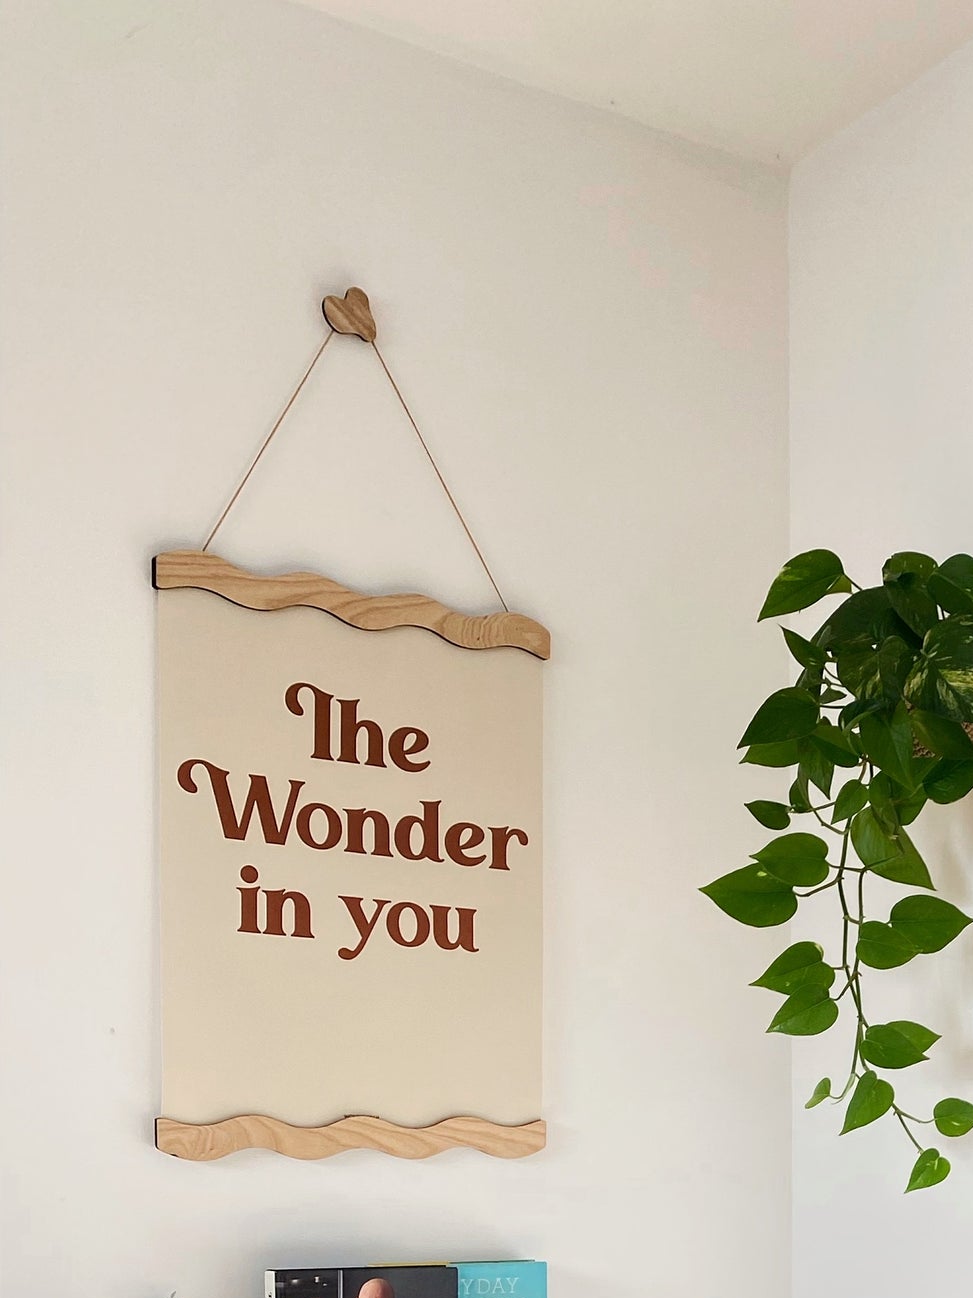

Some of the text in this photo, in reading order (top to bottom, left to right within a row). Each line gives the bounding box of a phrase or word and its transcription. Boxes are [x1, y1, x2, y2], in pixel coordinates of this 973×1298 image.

[285, 682, 431, 772] The
[177, 759, 529, 870] Wonder
[237, 865, 480, 960] in you
